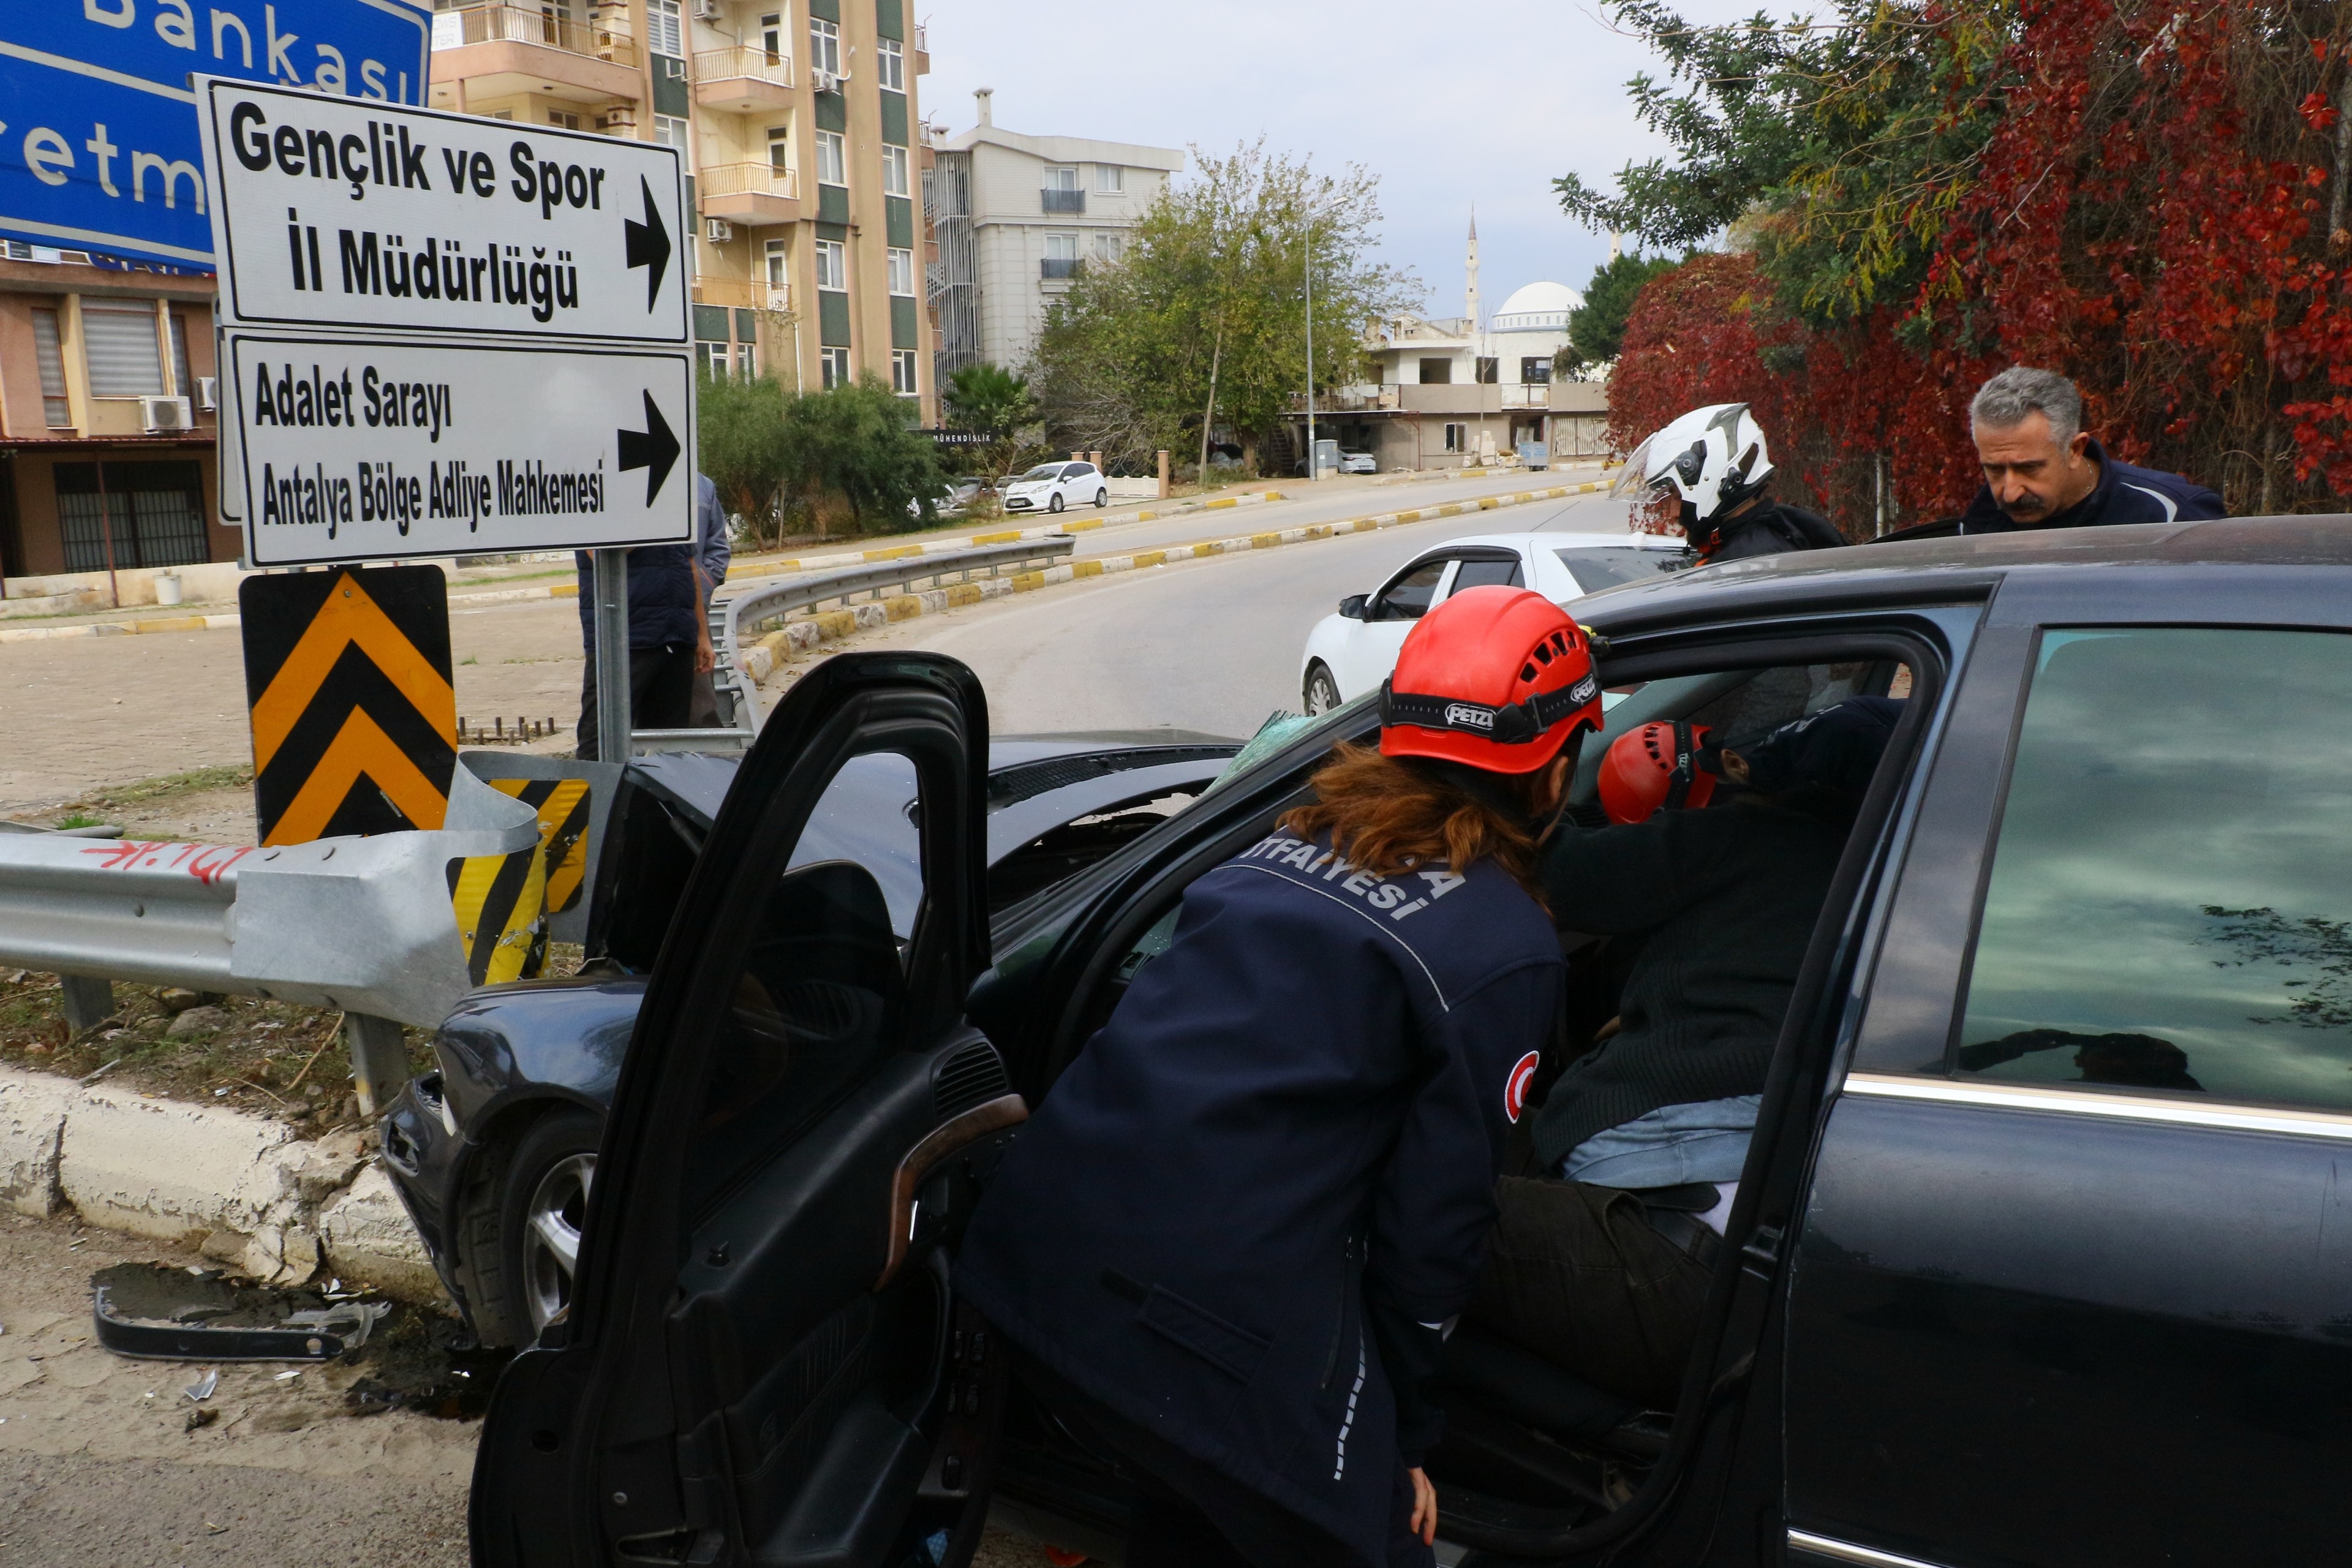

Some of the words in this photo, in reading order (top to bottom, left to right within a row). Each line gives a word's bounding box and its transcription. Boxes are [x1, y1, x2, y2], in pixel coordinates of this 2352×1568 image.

[0, 121, 206, 216] etm
[230, 101, 431, 201] Gençlik
[442, 148, 496, 198] ve
[510, 141, 605, 221] Spor
[288, 207, 323, 292] İl
[338, 228, 579, 323] Müdürlüğü
[255, 362, 355, 428] Adalet
[362, 365, 452, 443] Sarayı
[263, 462, 353, 540] Antalya
[358, 461, 422, 537] Bölge
[429, 460, 492, 533] Adliye
[497, 459, 605, 516] Mahkemesi
